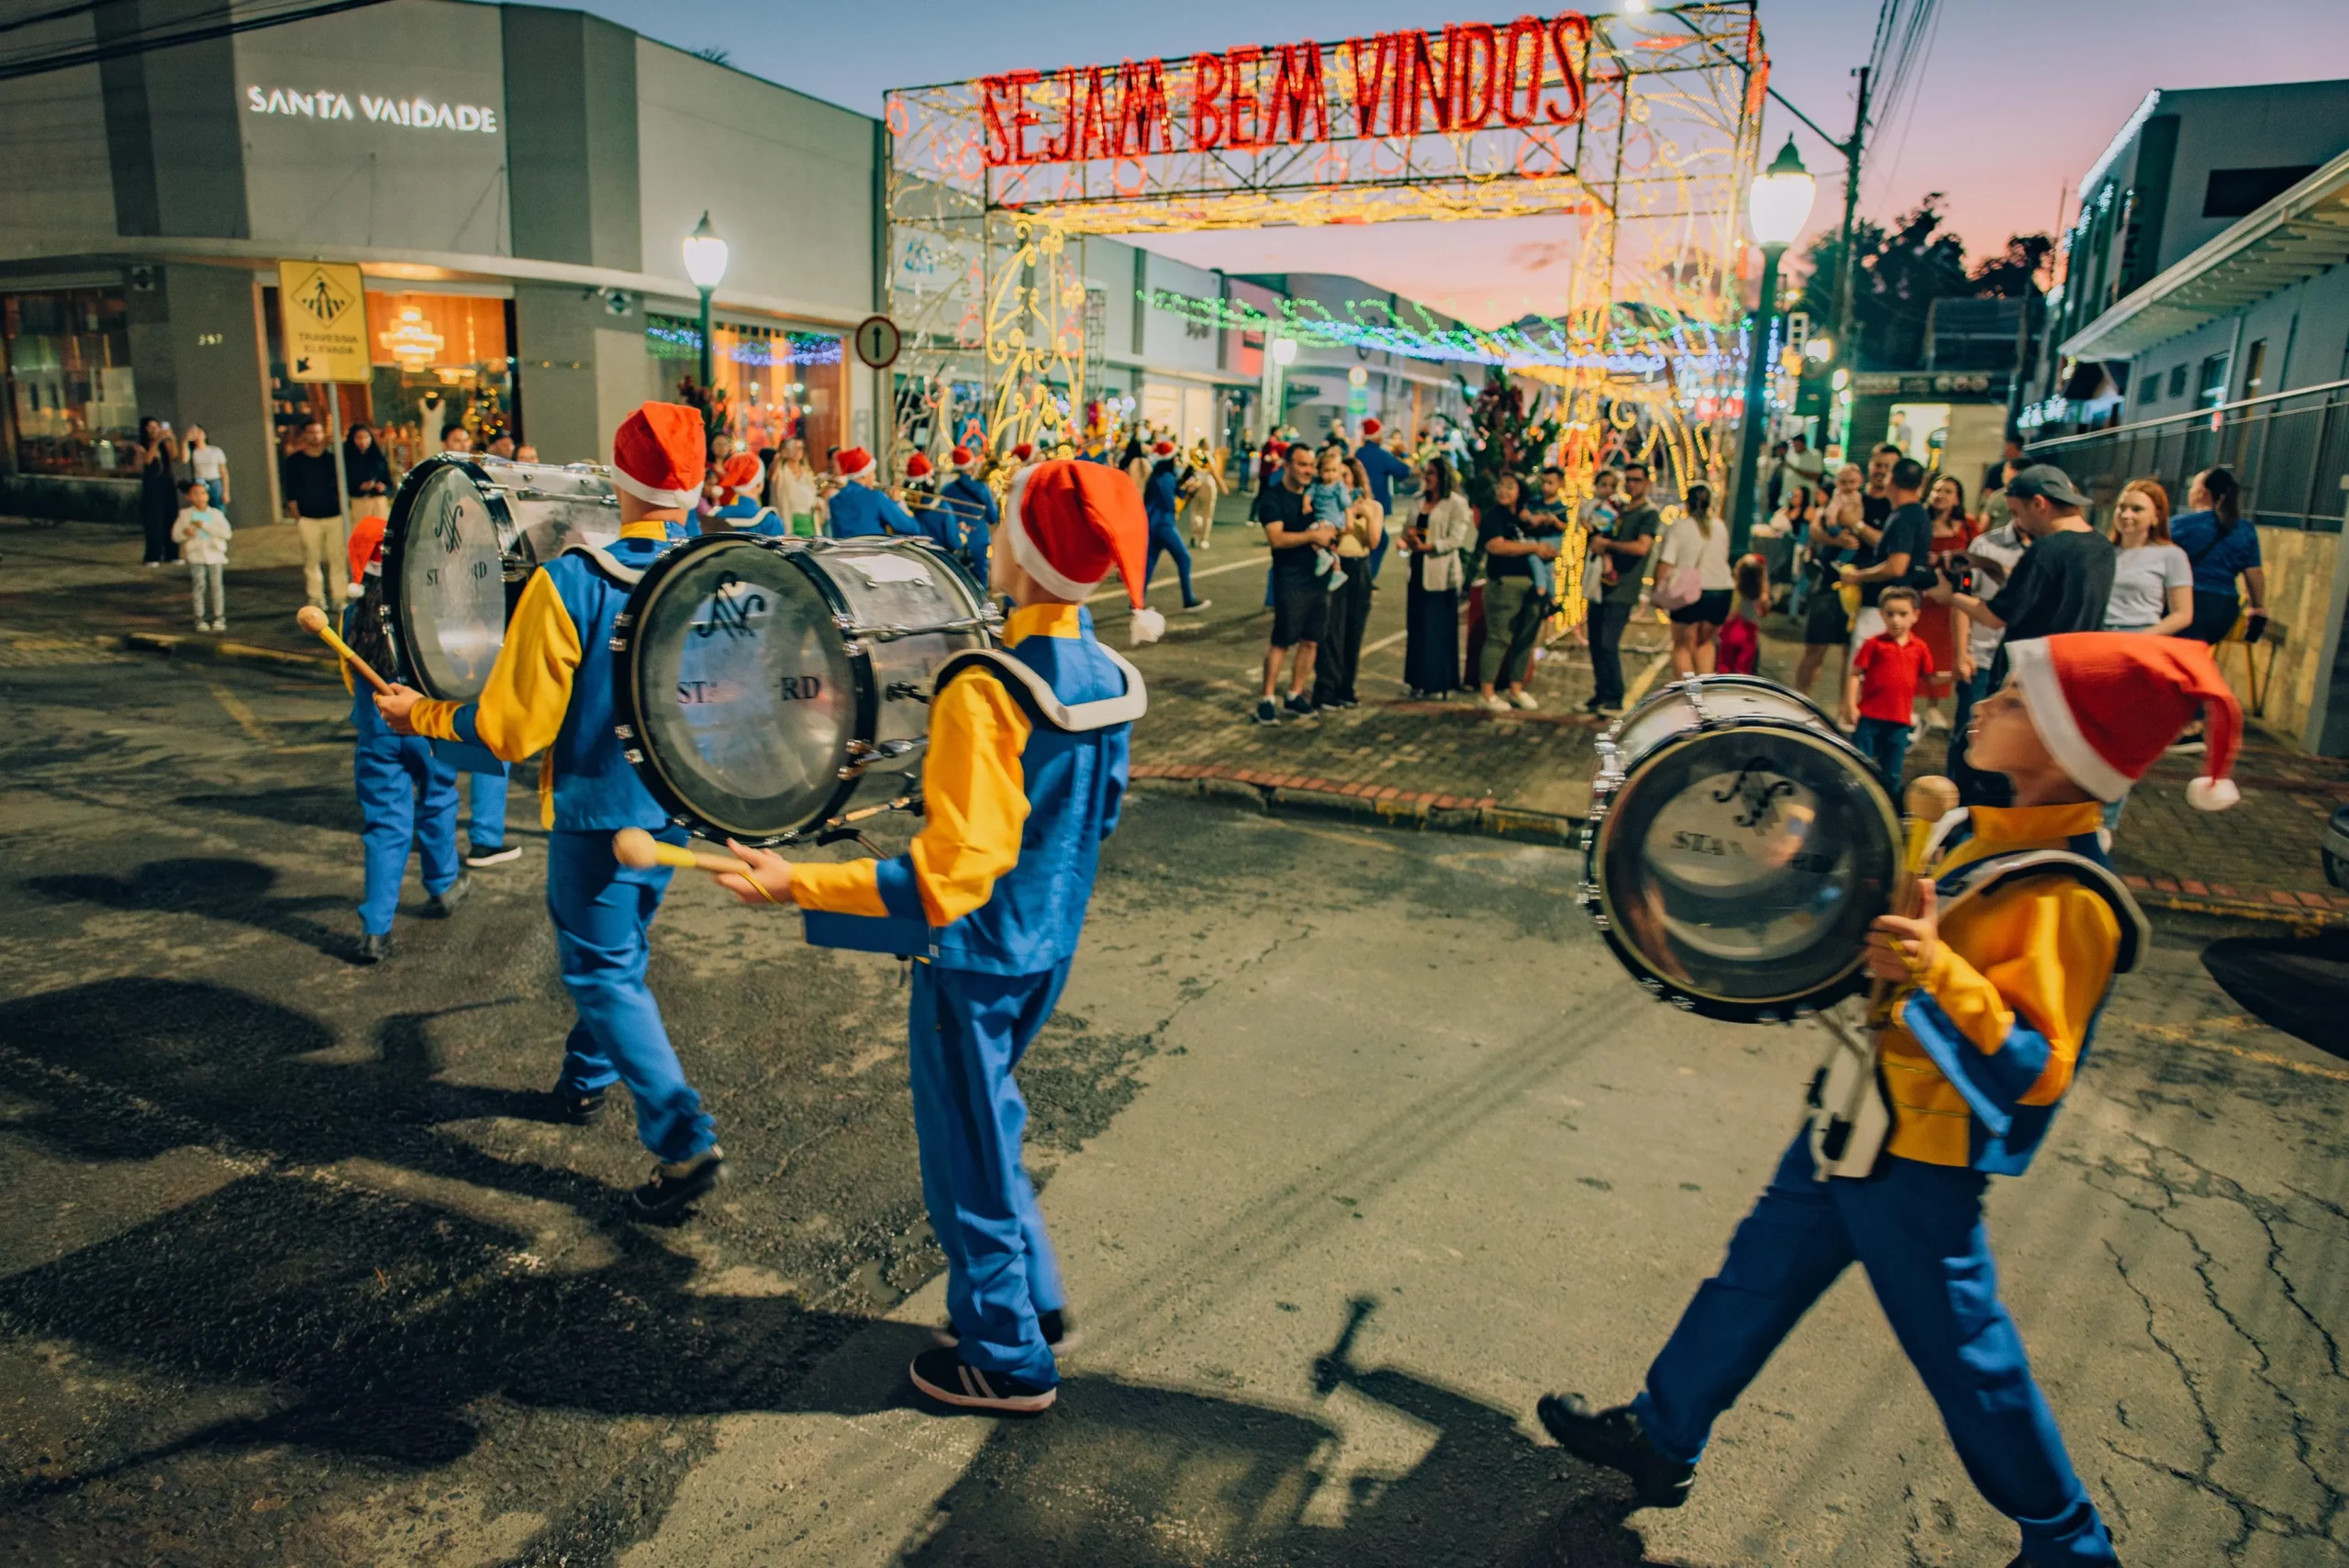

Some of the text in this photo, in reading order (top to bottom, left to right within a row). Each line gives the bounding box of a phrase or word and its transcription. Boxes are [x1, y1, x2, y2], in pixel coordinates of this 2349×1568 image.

[247, 86, 497, 132] SANTA VAIDADE
[979, 9, 1594, 166] SEJAM BEM VINDOS
[298, 332, 359, 344] TRAVESSIA
